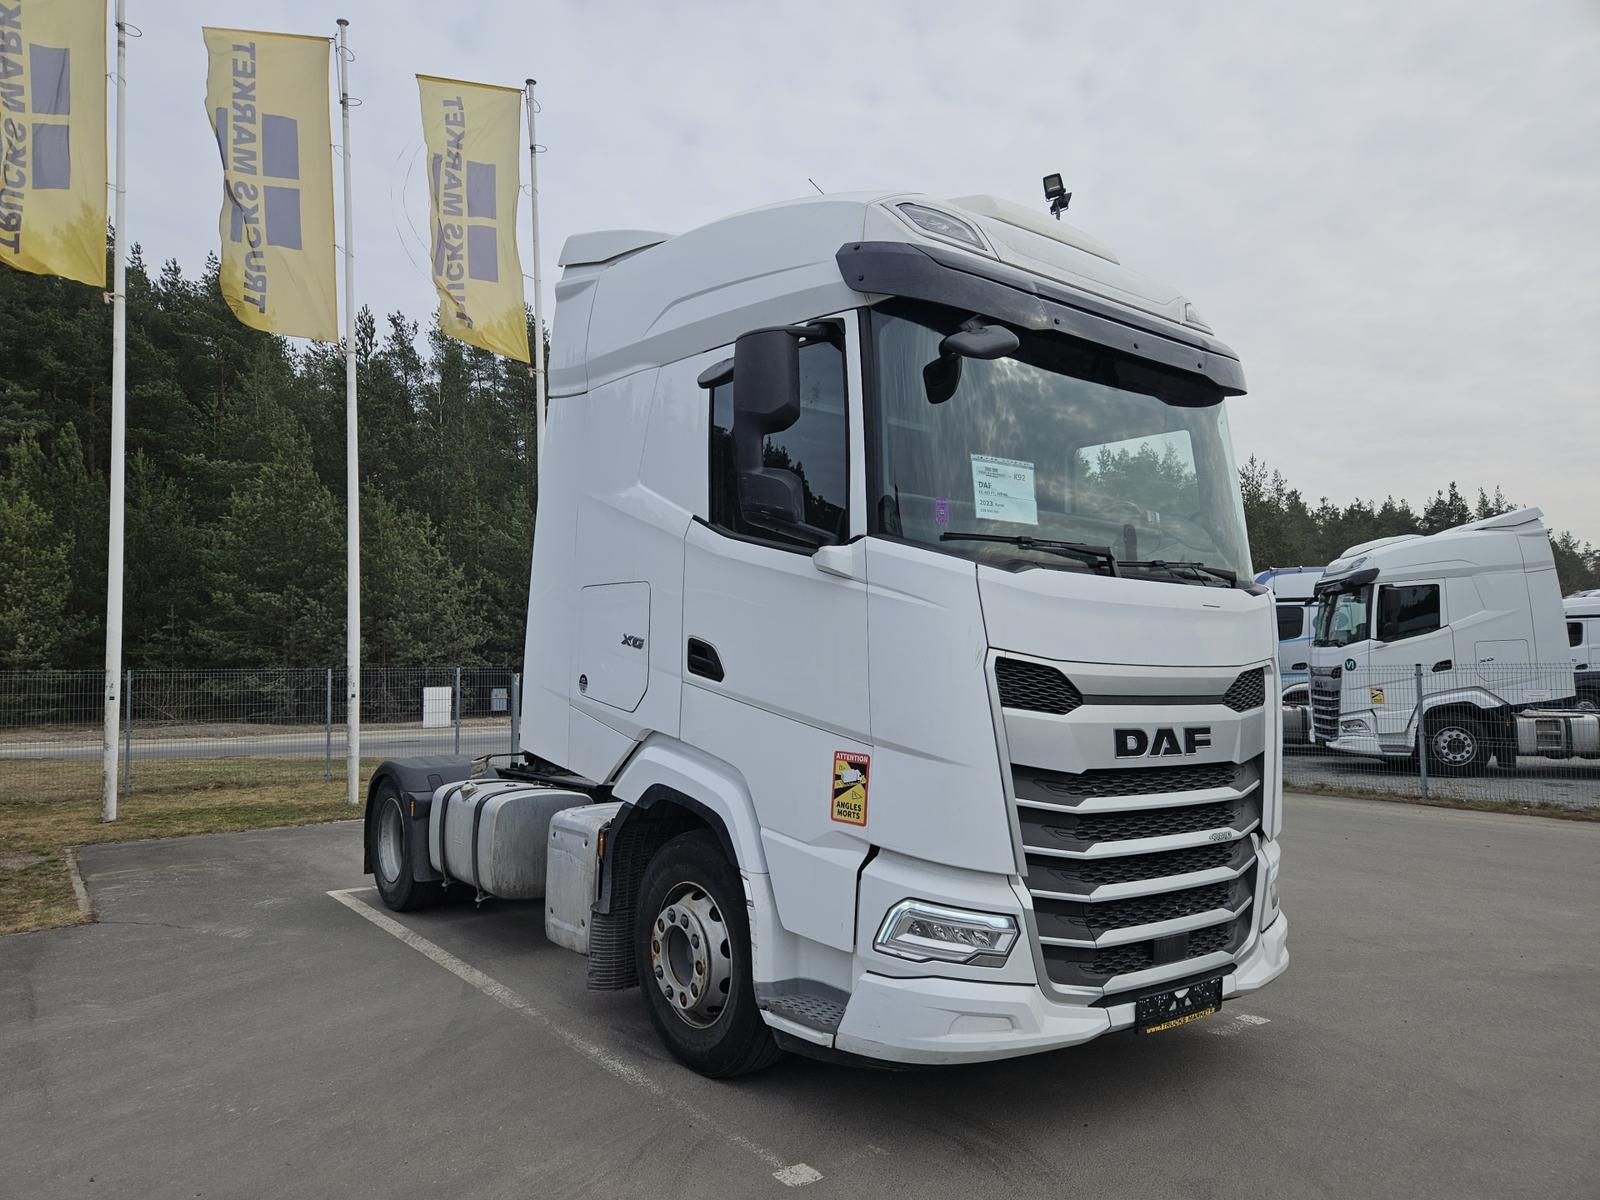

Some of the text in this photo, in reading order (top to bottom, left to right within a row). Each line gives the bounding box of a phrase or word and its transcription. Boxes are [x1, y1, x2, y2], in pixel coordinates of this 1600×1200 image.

[978, 481, 992, 489] DAF
[621, 633, 645, 650] XG
[1113, 727, 1212, 759] DAF
[836, 753, 869, 763] ATTENTION
[836, 800, 862, 812] ANGLES
[837, 809, 860, 819] MORTS
